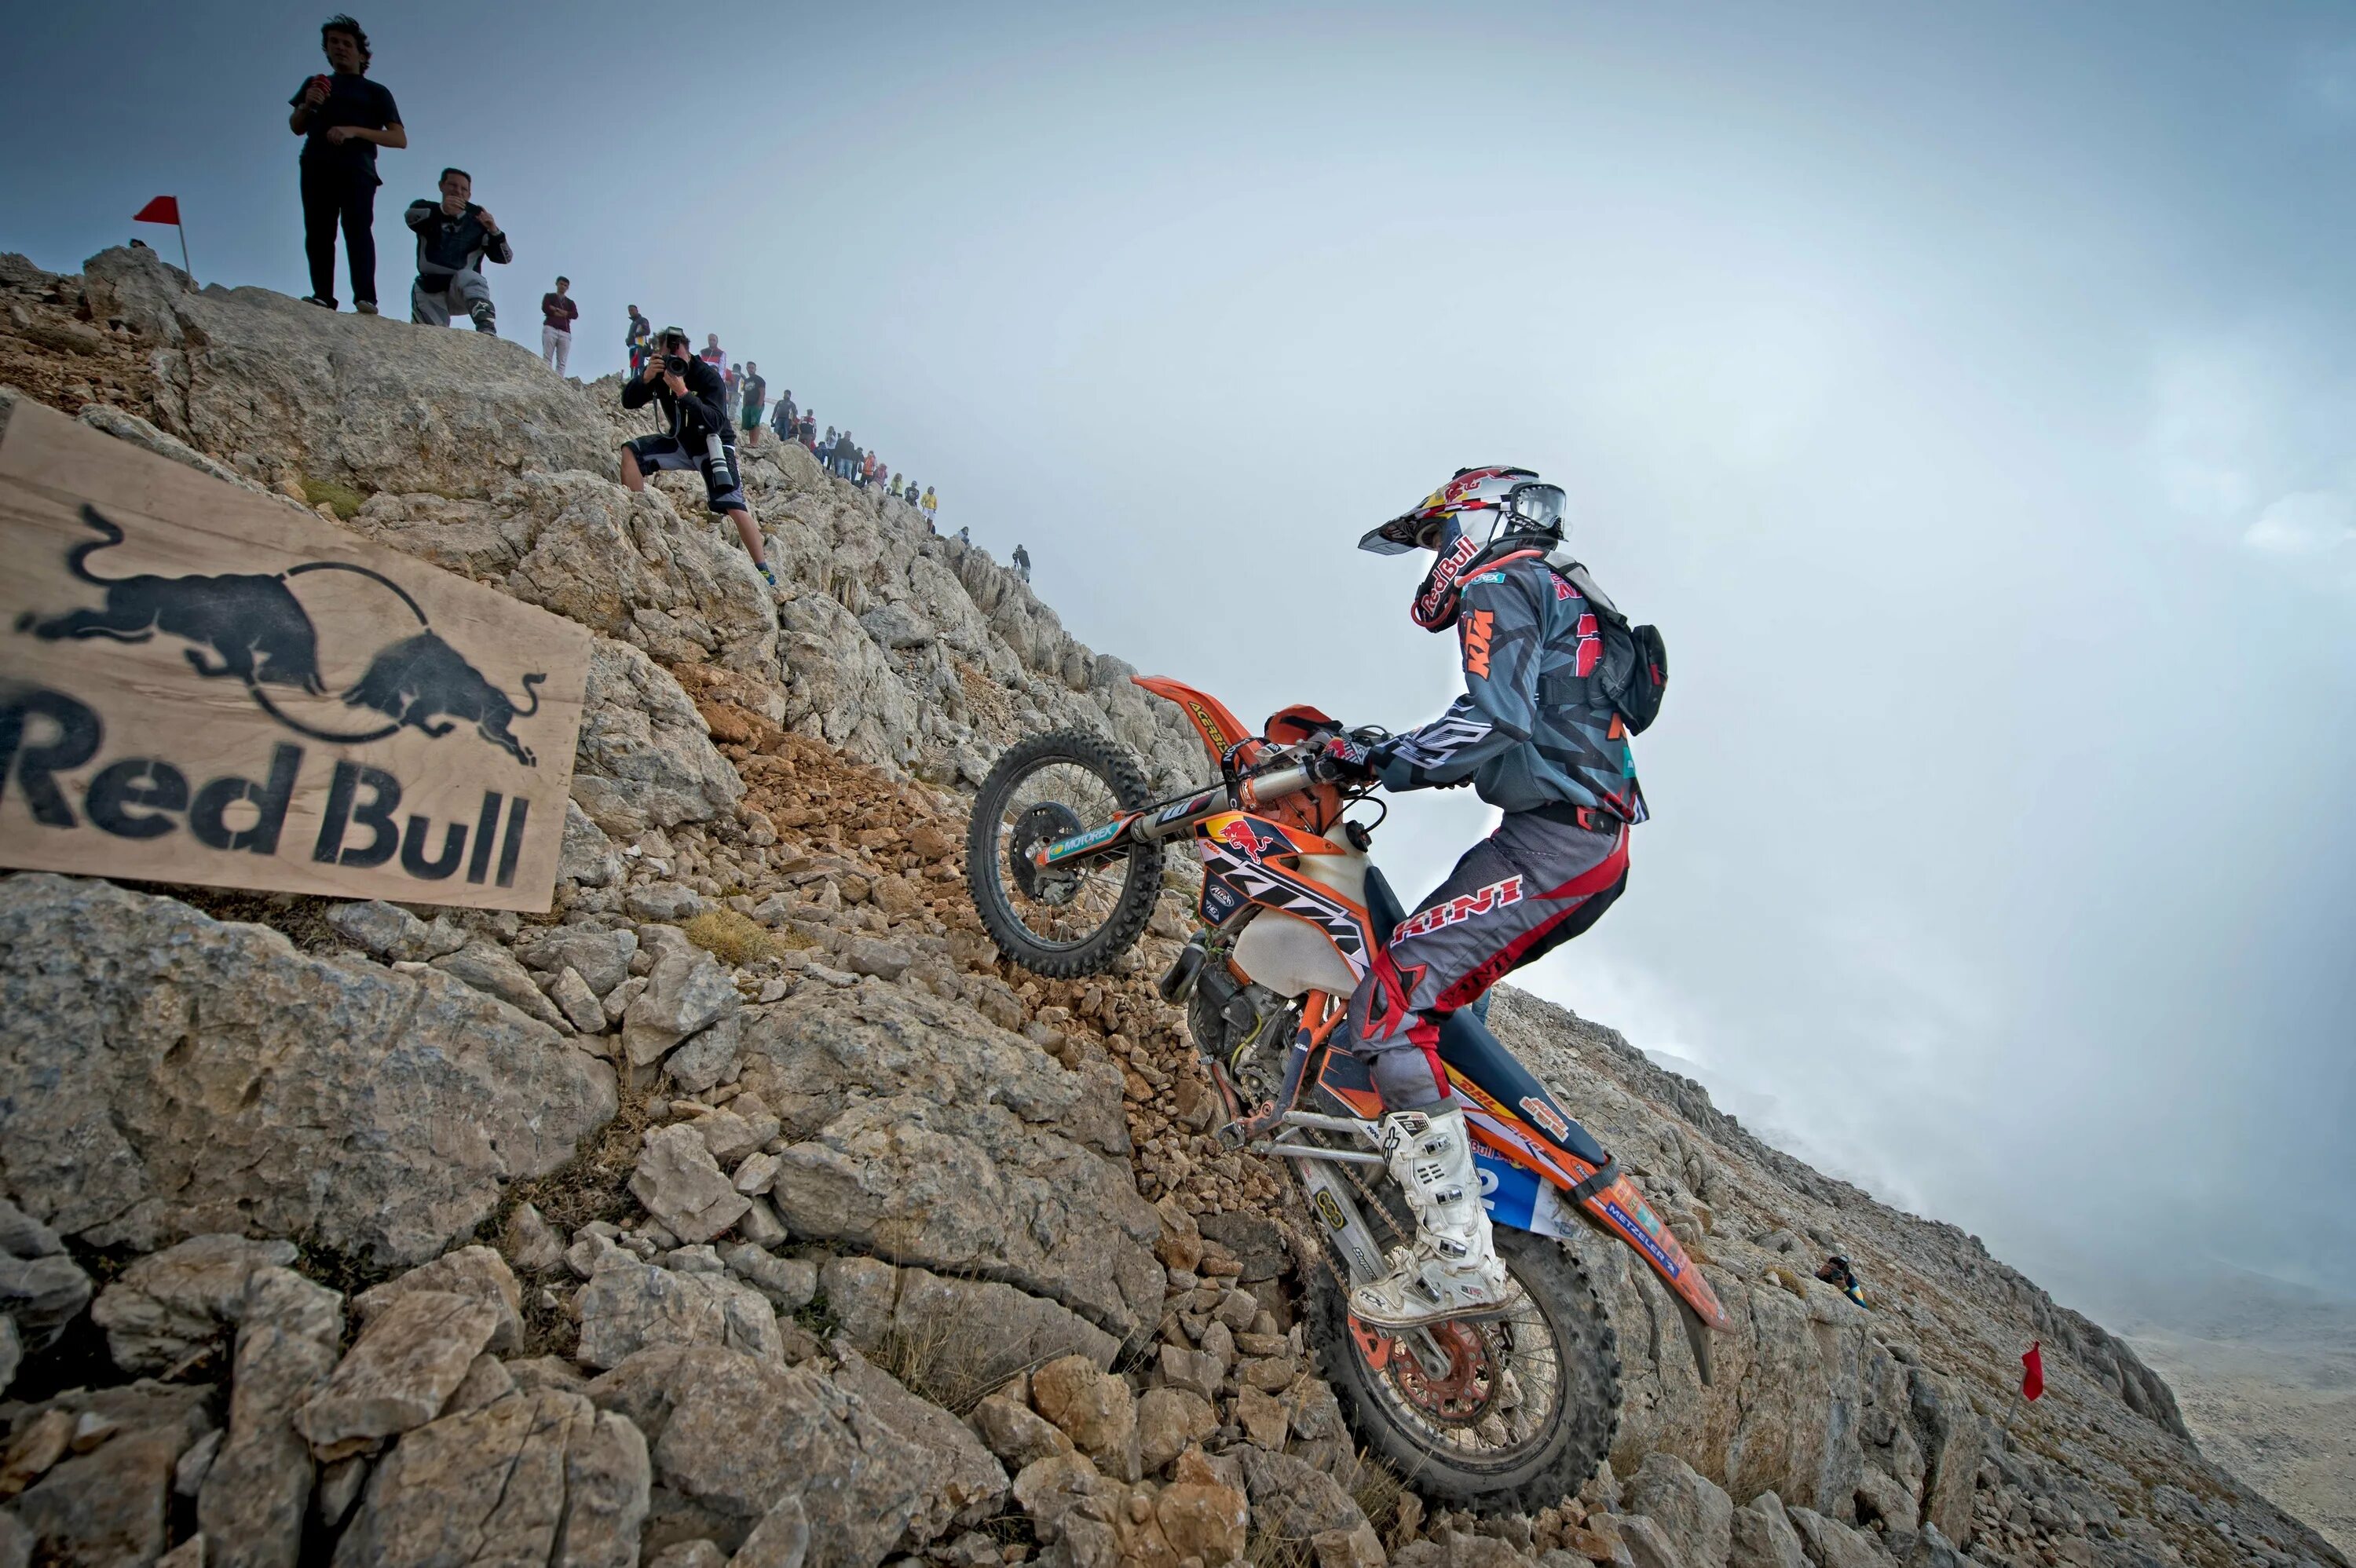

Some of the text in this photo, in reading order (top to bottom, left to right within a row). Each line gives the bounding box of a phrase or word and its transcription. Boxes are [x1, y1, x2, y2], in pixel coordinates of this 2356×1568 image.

[1421, 535, 1480, 617] Red Bull
[1465, 609, 1494, 682] KTM
[0, 688, 529, 888] Red Bull
[1063, 825, 1113, 852] MOTOREX
[1210, 886, 1231, 905] Airoh
[1390, 874, 1523, 949] KINI
[1295, 1043, 1309, 1053] KTM
[1458, 1079, 1497, 1112] DHL
[1470, 1139, 1495, 1160] Bull
[1608, 1204, 1666, 1263] METZELER
